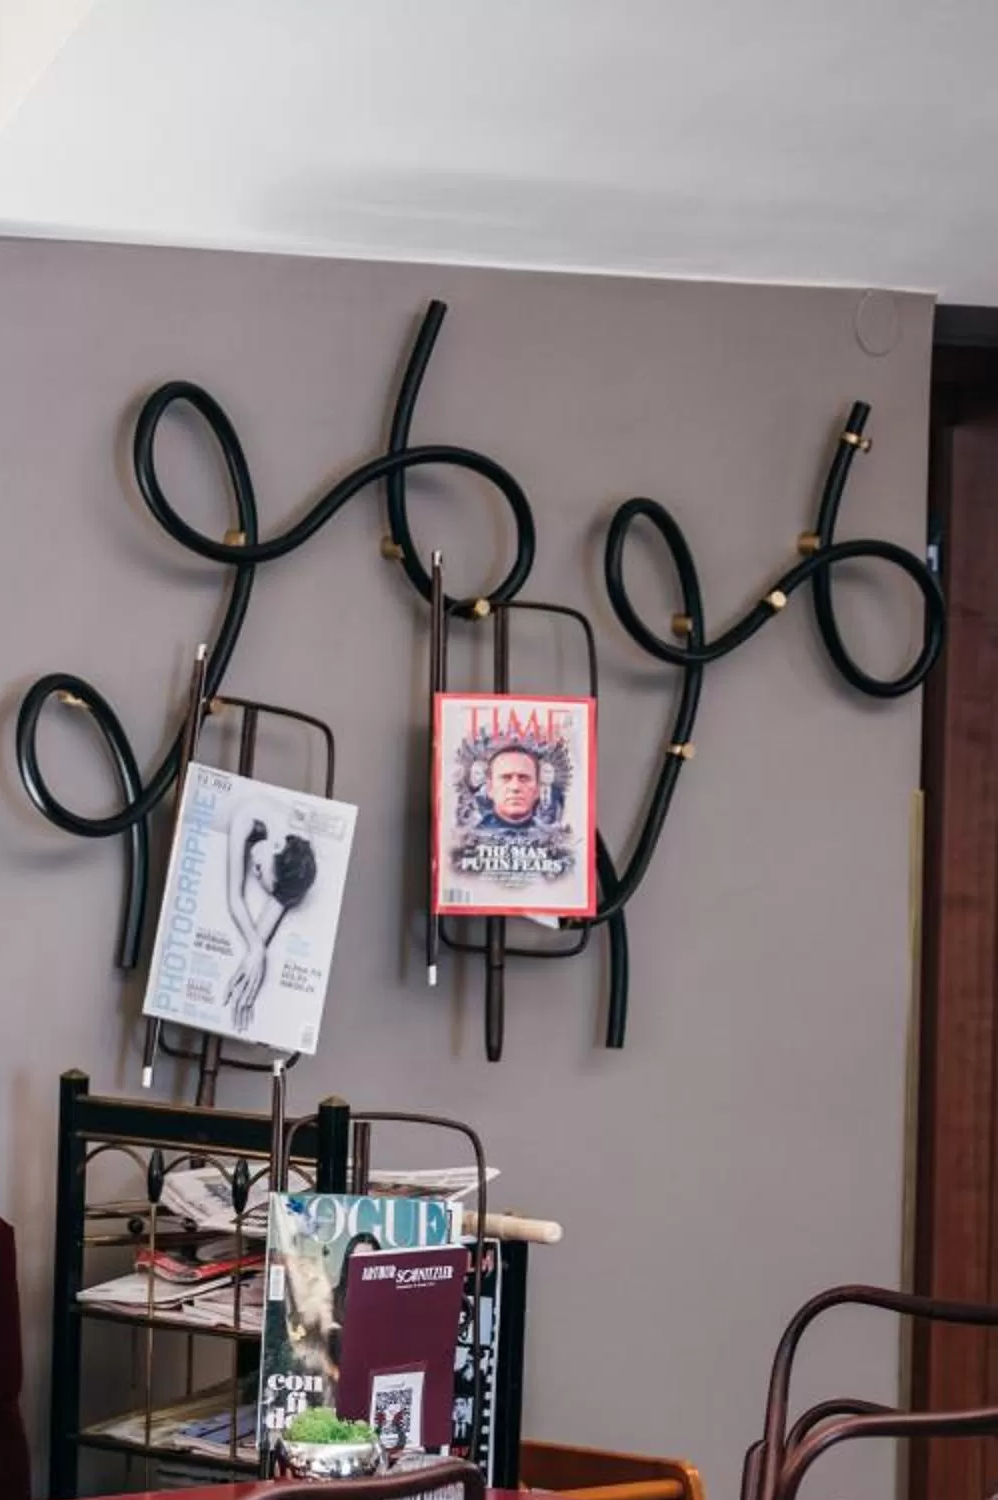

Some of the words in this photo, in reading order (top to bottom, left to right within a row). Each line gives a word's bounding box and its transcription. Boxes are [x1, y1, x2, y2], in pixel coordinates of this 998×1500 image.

[463, 705, 571, 742] TIME
[462, 855, 511, 872] PUTIN
[512, 857, 563, 873] FEARS
[476, 843, 506, 859] THE
[510, 845, 548, 860] MAN
[153, 789, 215, 1012] PHOTOGRAPHIE
[277, 1196, 448, 1249] OGUE
[267, 1372, 324, 1393] con
